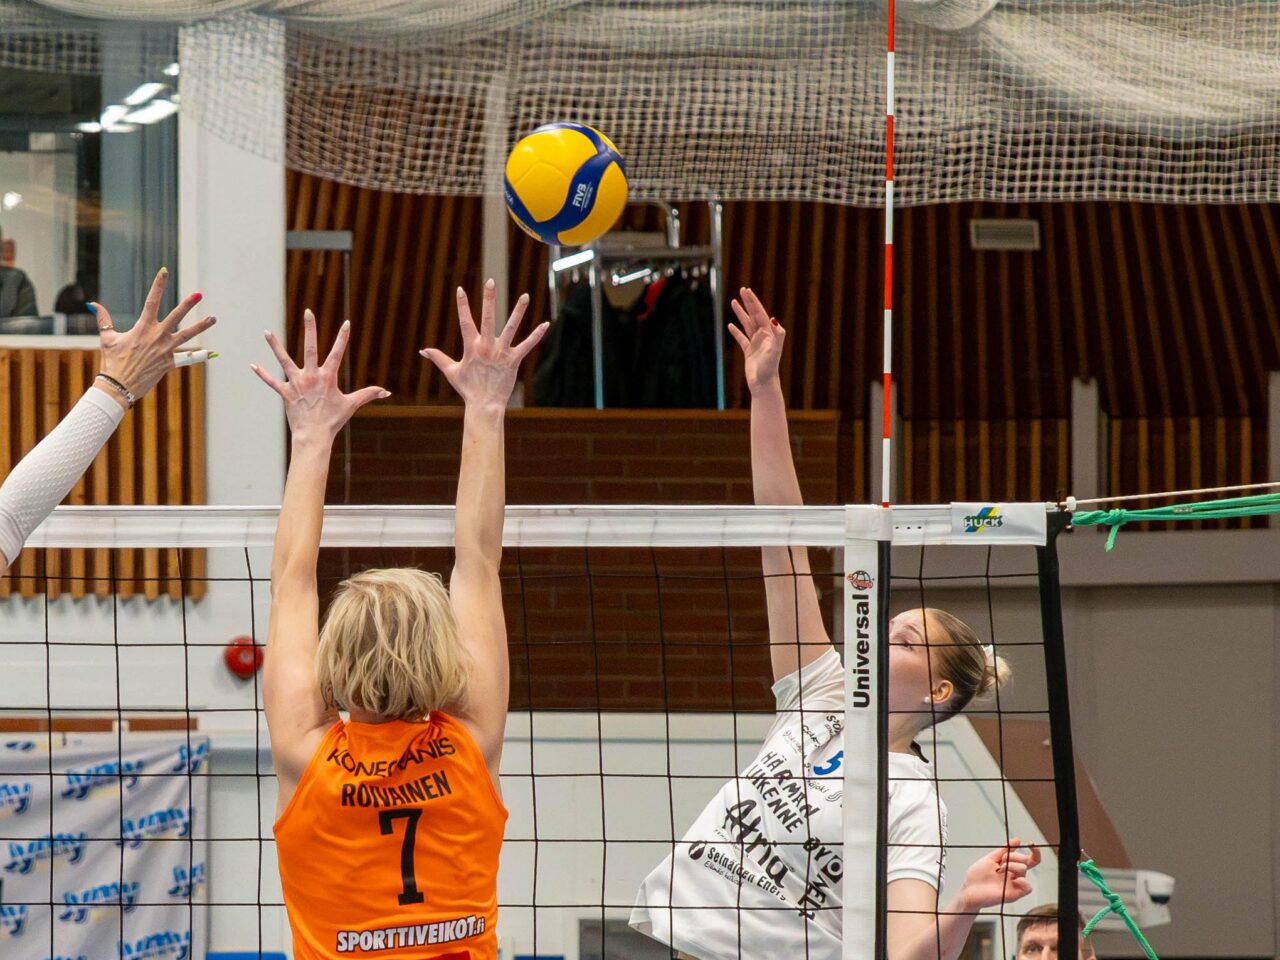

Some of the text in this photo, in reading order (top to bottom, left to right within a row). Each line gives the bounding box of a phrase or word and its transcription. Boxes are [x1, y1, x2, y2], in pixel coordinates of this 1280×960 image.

[572, 183, 587, 207] FIVB
[963, 515, 1004, 528] HUCK
[852, 594, 870, 708] Universal
[341, 770, 453, 808] ROIVAINEN
[379, 808, 425, 906] 7
[336, 915, 486, 952] SPORTTIVEIKOT.fi
